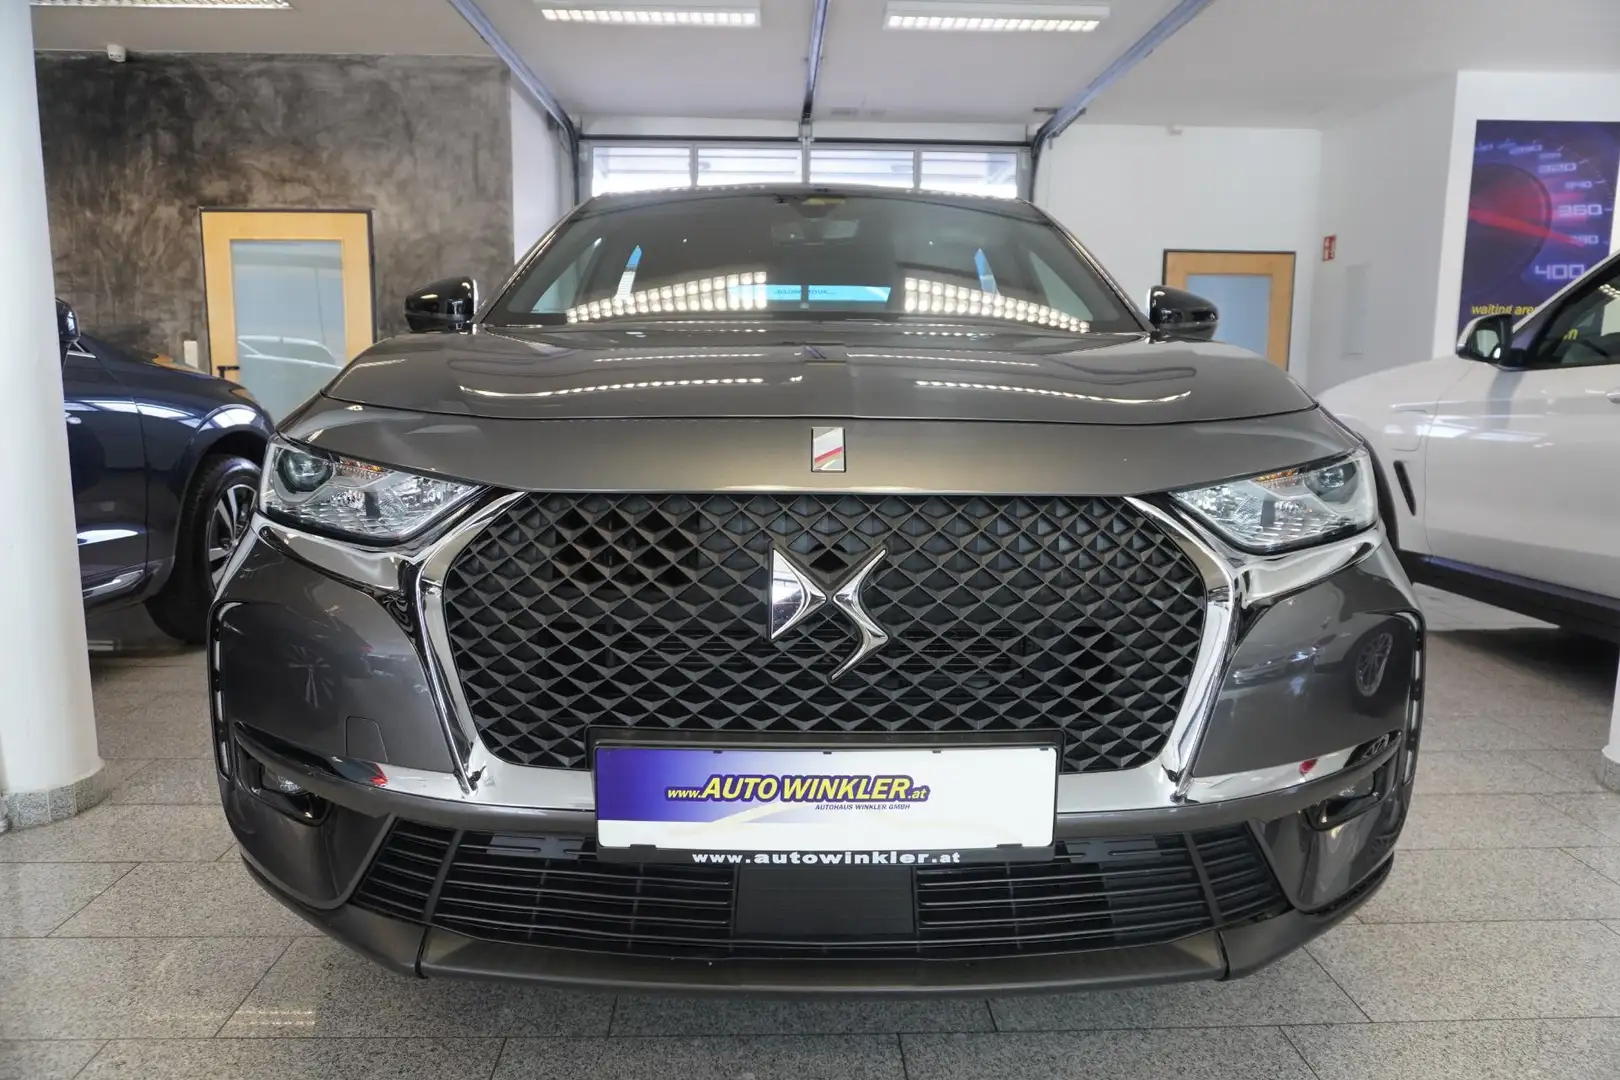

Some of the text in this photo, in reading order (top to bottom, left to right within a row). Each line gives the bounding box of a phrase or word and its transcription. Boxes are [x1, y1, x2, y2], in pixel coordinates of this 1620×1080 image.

[1558, 204, 1603, 216] 360
[1535, 264, 1585, 280] 400
[1514, 305, 1537, 316] are
[814, 803, 911, 811] AUTOHAUS WINKLER GMBH
[692, 850, 961, 865] www.autowinkler.at
